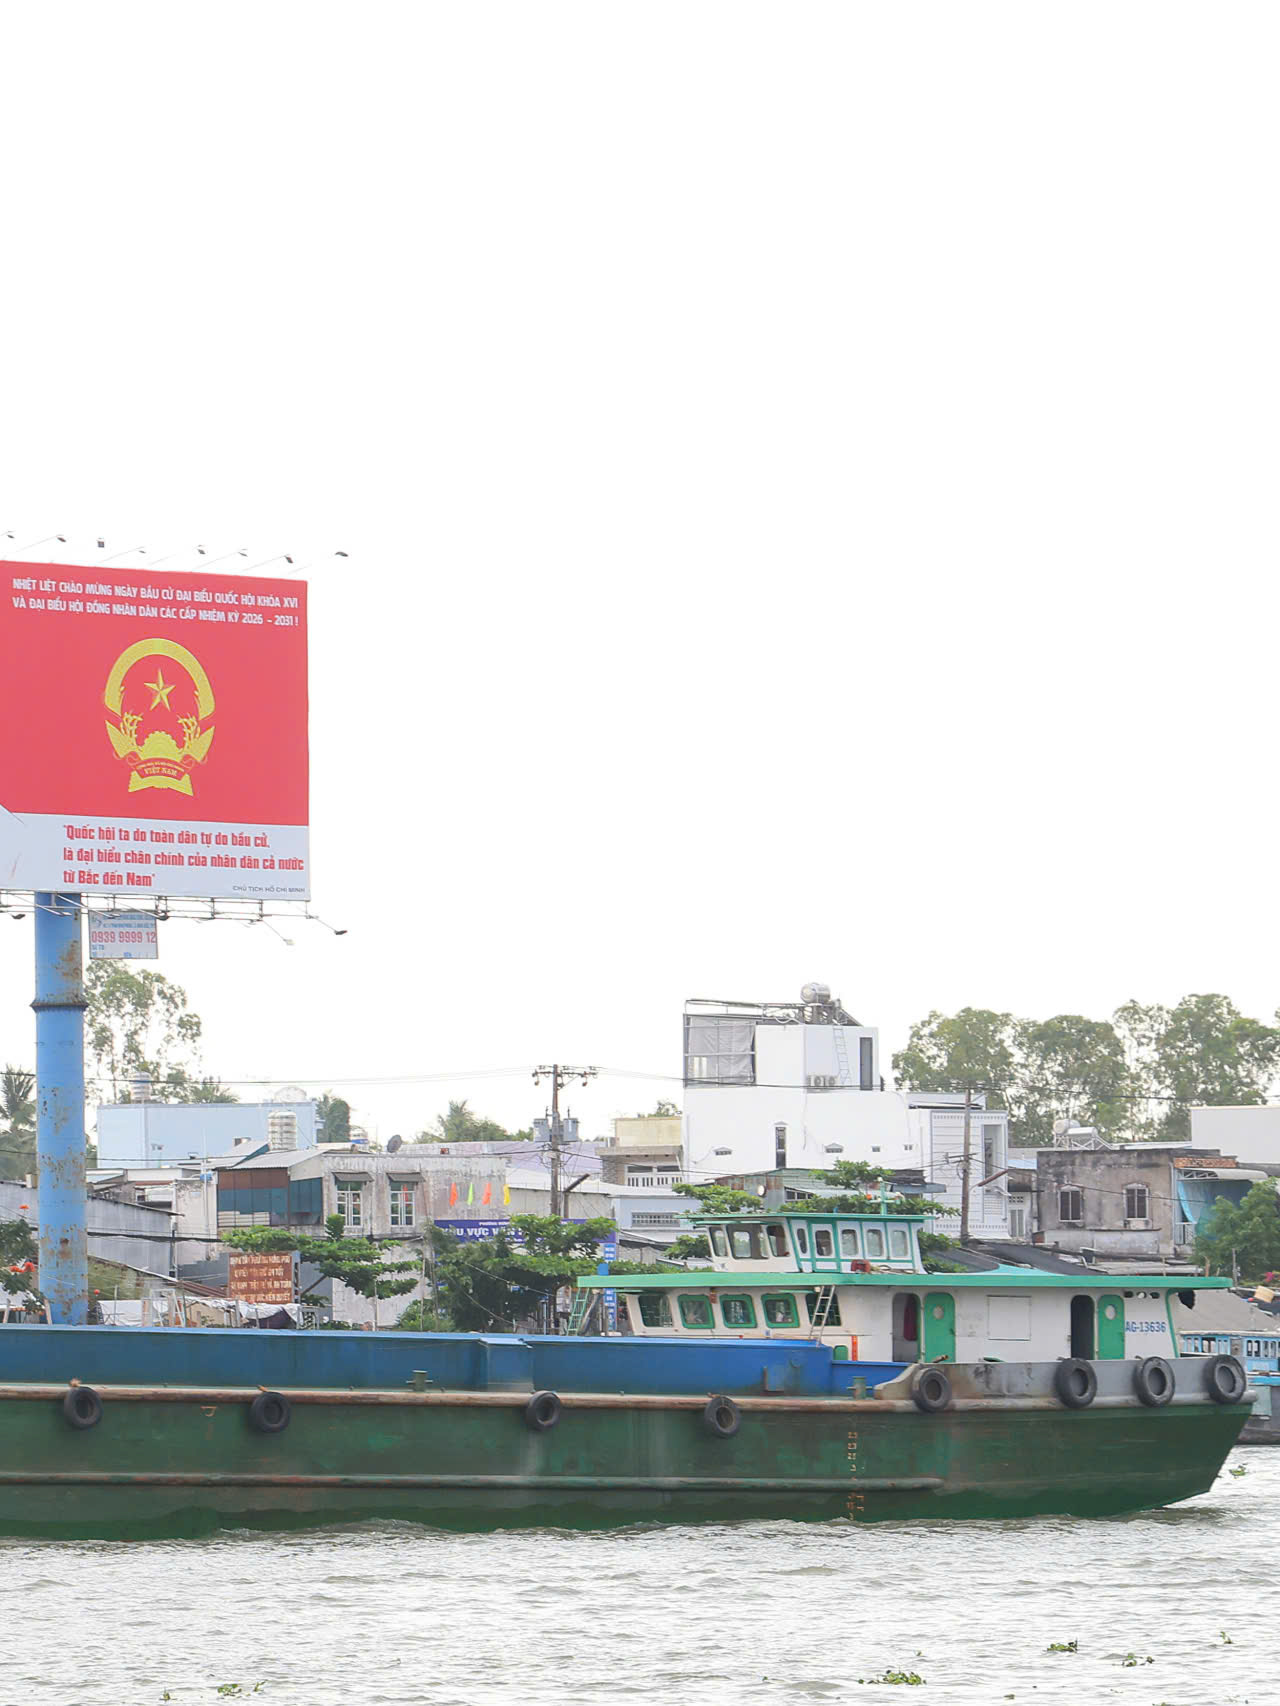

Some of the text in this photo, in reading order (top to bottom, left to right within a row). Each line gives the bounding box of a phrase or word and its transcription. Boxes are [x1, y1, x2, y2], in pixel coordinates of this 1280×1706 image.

[12, 577, 37, 592] NHIỆT
[39, 578, 57, 594] LIỆT
[59, 580, 83, 594] CHÀO
[86, 582, 112, 596] MỪNG
[115, 583, 138, 598] NGÀY
[162, 585, 174, 600] CỬ
[176, 589, 192, 603] ĐẠI
[215, 590, 238, 605] QUỐC
[240, 593, 255, 607] HỘI
[257, 595, 281, 608] KHÓA
[283, 597, 298, 609] XVI
[12, 596, 26, 609] VÀ
[29, 598, 45, 611] ĐẠI
[69, 599, 83, 613] HỘI
[86, 600, 110, 615] ĐỒNG
[112, 602, 137, 616] NHÂN
[139, 603, 158, 618] DÂN
[160, 604, 177, 619] CÁC
[179, 605, 197, 620] CẤP
[199, 608, 226, 623] NHIỆM
[228, 609, 239, 623] KỲ
[242, 613, 263, 625] 2026
[98, 826, 115, 844] hội
[119, 828, 130, 842] ta
[133, 828, 147, 842] do
[150, 829, 174, 844] toàn
[178, 830, 198, 845] dân
[201, 831, 212, 848] tự
[215, 832, 229, 846] do
[63, 846, 304, 871] là đại biểu chân chính của nhân dân cả nước
[63, 870, 75, 884] từ
[78, 869, 99, 884] Bác
[102, 870, 123, 886] đến
[91, 931, 157, 943] 0939 9999 12
[466, 1228, 489, 1238] VỰC
[1125, 1321, 1167, 1332] AG-13636
